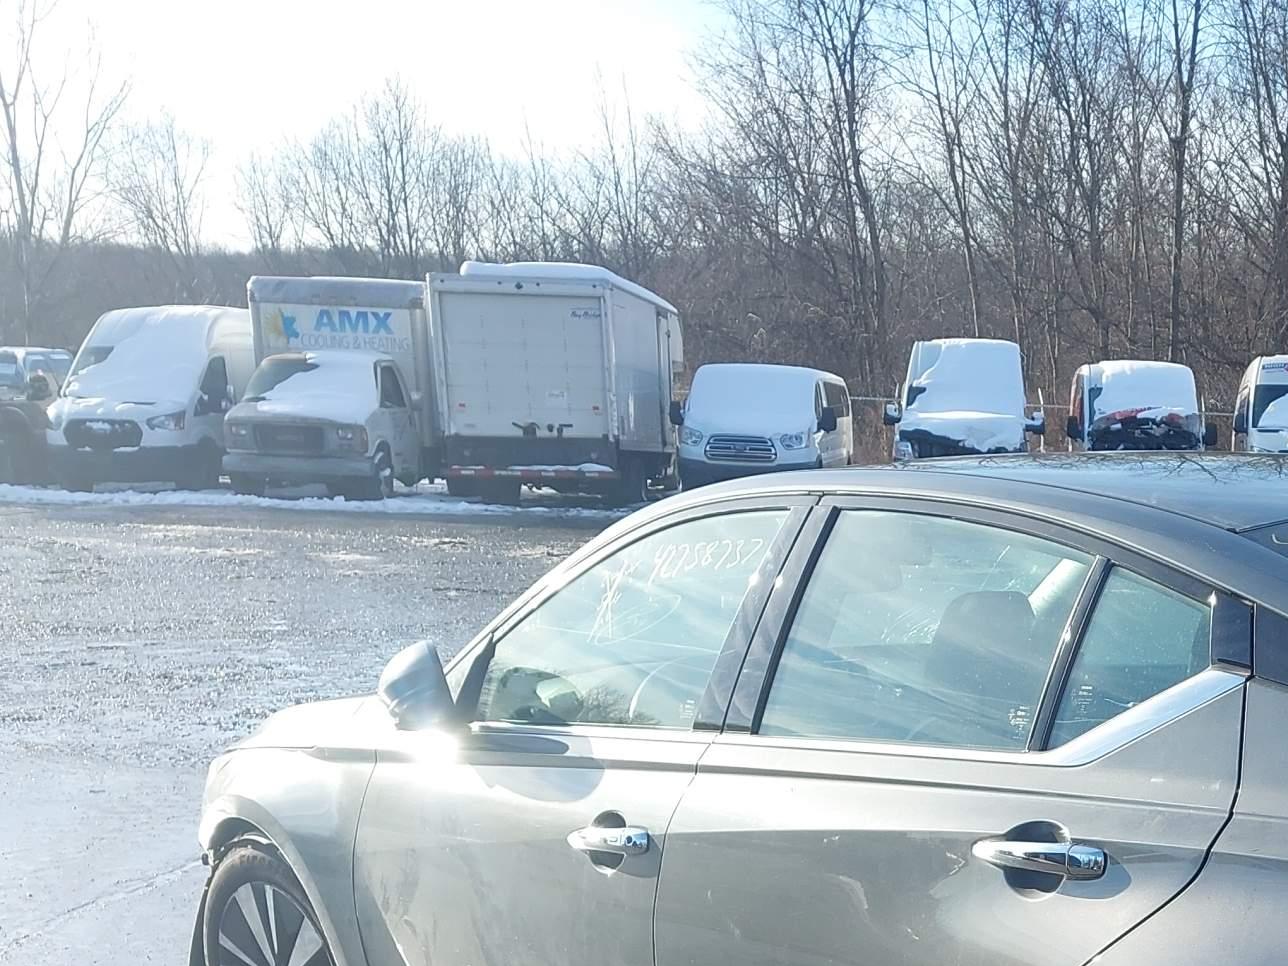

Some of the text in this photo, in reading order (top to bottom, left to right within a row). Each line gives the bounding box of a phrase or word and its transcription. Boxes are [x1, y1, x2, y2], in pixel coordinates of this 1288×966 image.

[314, 308, 394, 335] AMX
[300, 332, 410, 350] COOLING & HEATING
